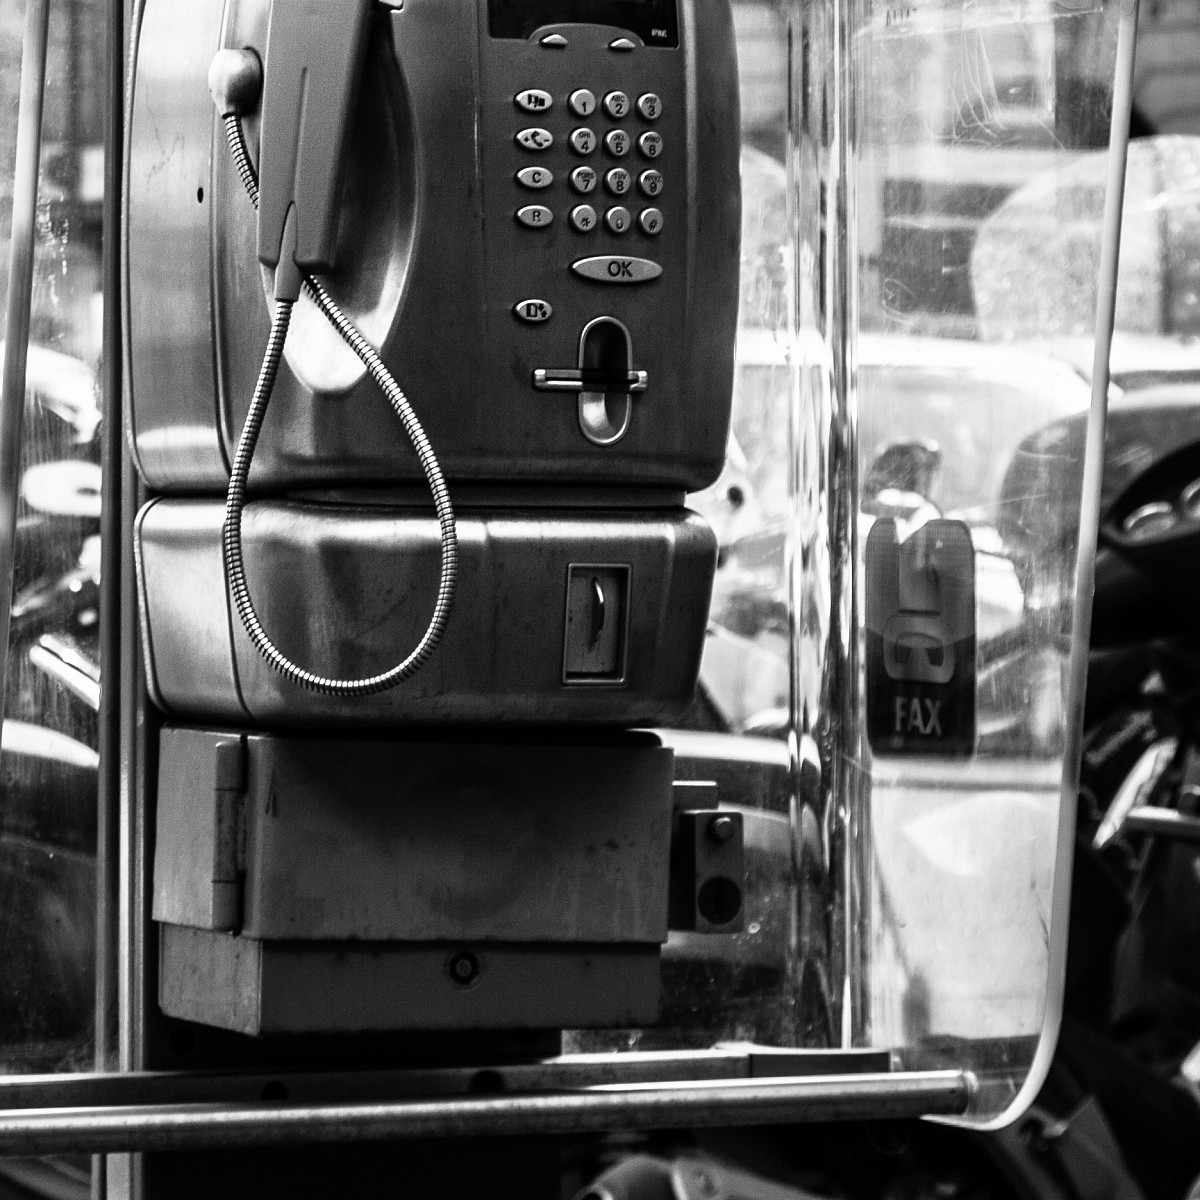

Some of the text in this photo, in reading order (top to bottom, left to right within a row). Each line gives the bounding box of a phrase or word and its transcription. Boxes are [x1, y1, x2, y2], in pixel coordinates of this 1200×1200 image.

[615, 103, 624, 115] 2
[648, 105, 656, 117] 3
[581, 140, 589, 152] 4
[615, 142, 623, 154] 5
[532, 171, 542, 183] C
[583, 179, 590, 190] 7
[616, 180, 624, 192] 8
[532, 210, 541, 223] R
[607, 260, 633, 278] OK
[895, 696, 943, 737] FAX
